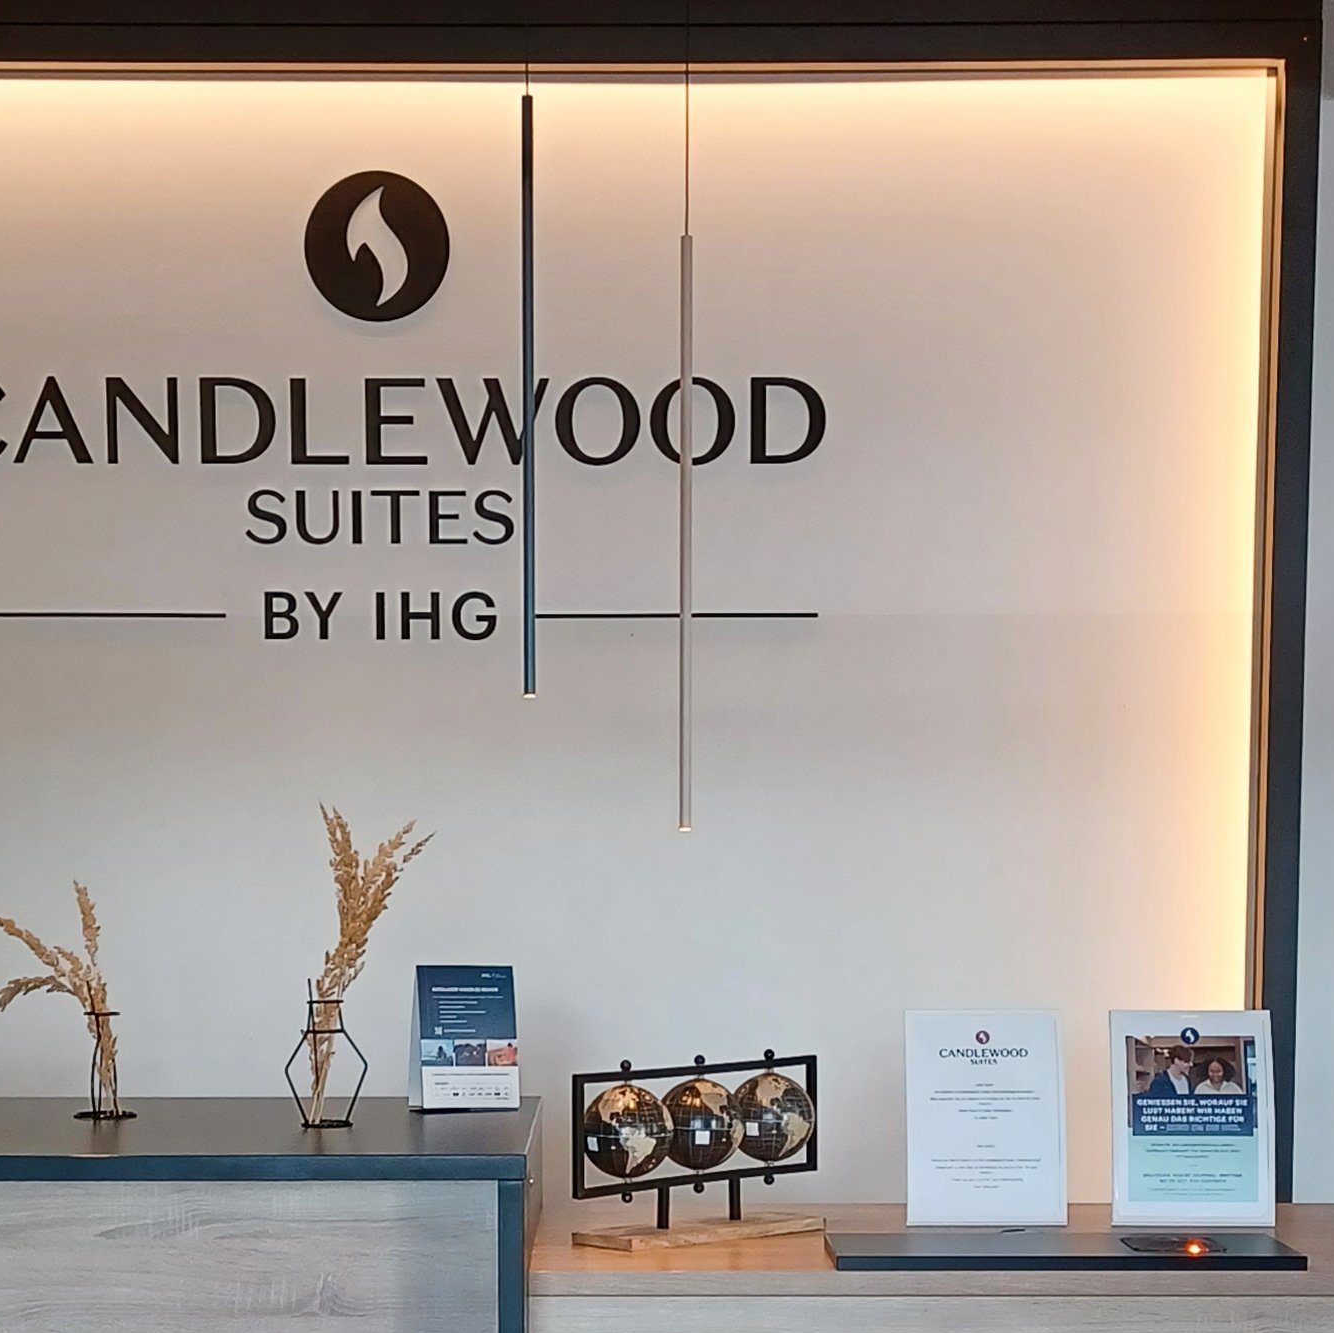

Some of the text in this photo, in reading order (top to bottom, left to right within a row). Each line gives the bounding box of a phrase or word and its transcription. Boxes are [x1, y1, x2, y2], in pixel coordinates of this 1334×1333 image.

[245, 489, 515, 545] SUITES
[264, 591, 499, 640] BY IHG
[939, 1048, 1028, 1058] CANDLEWOOD
